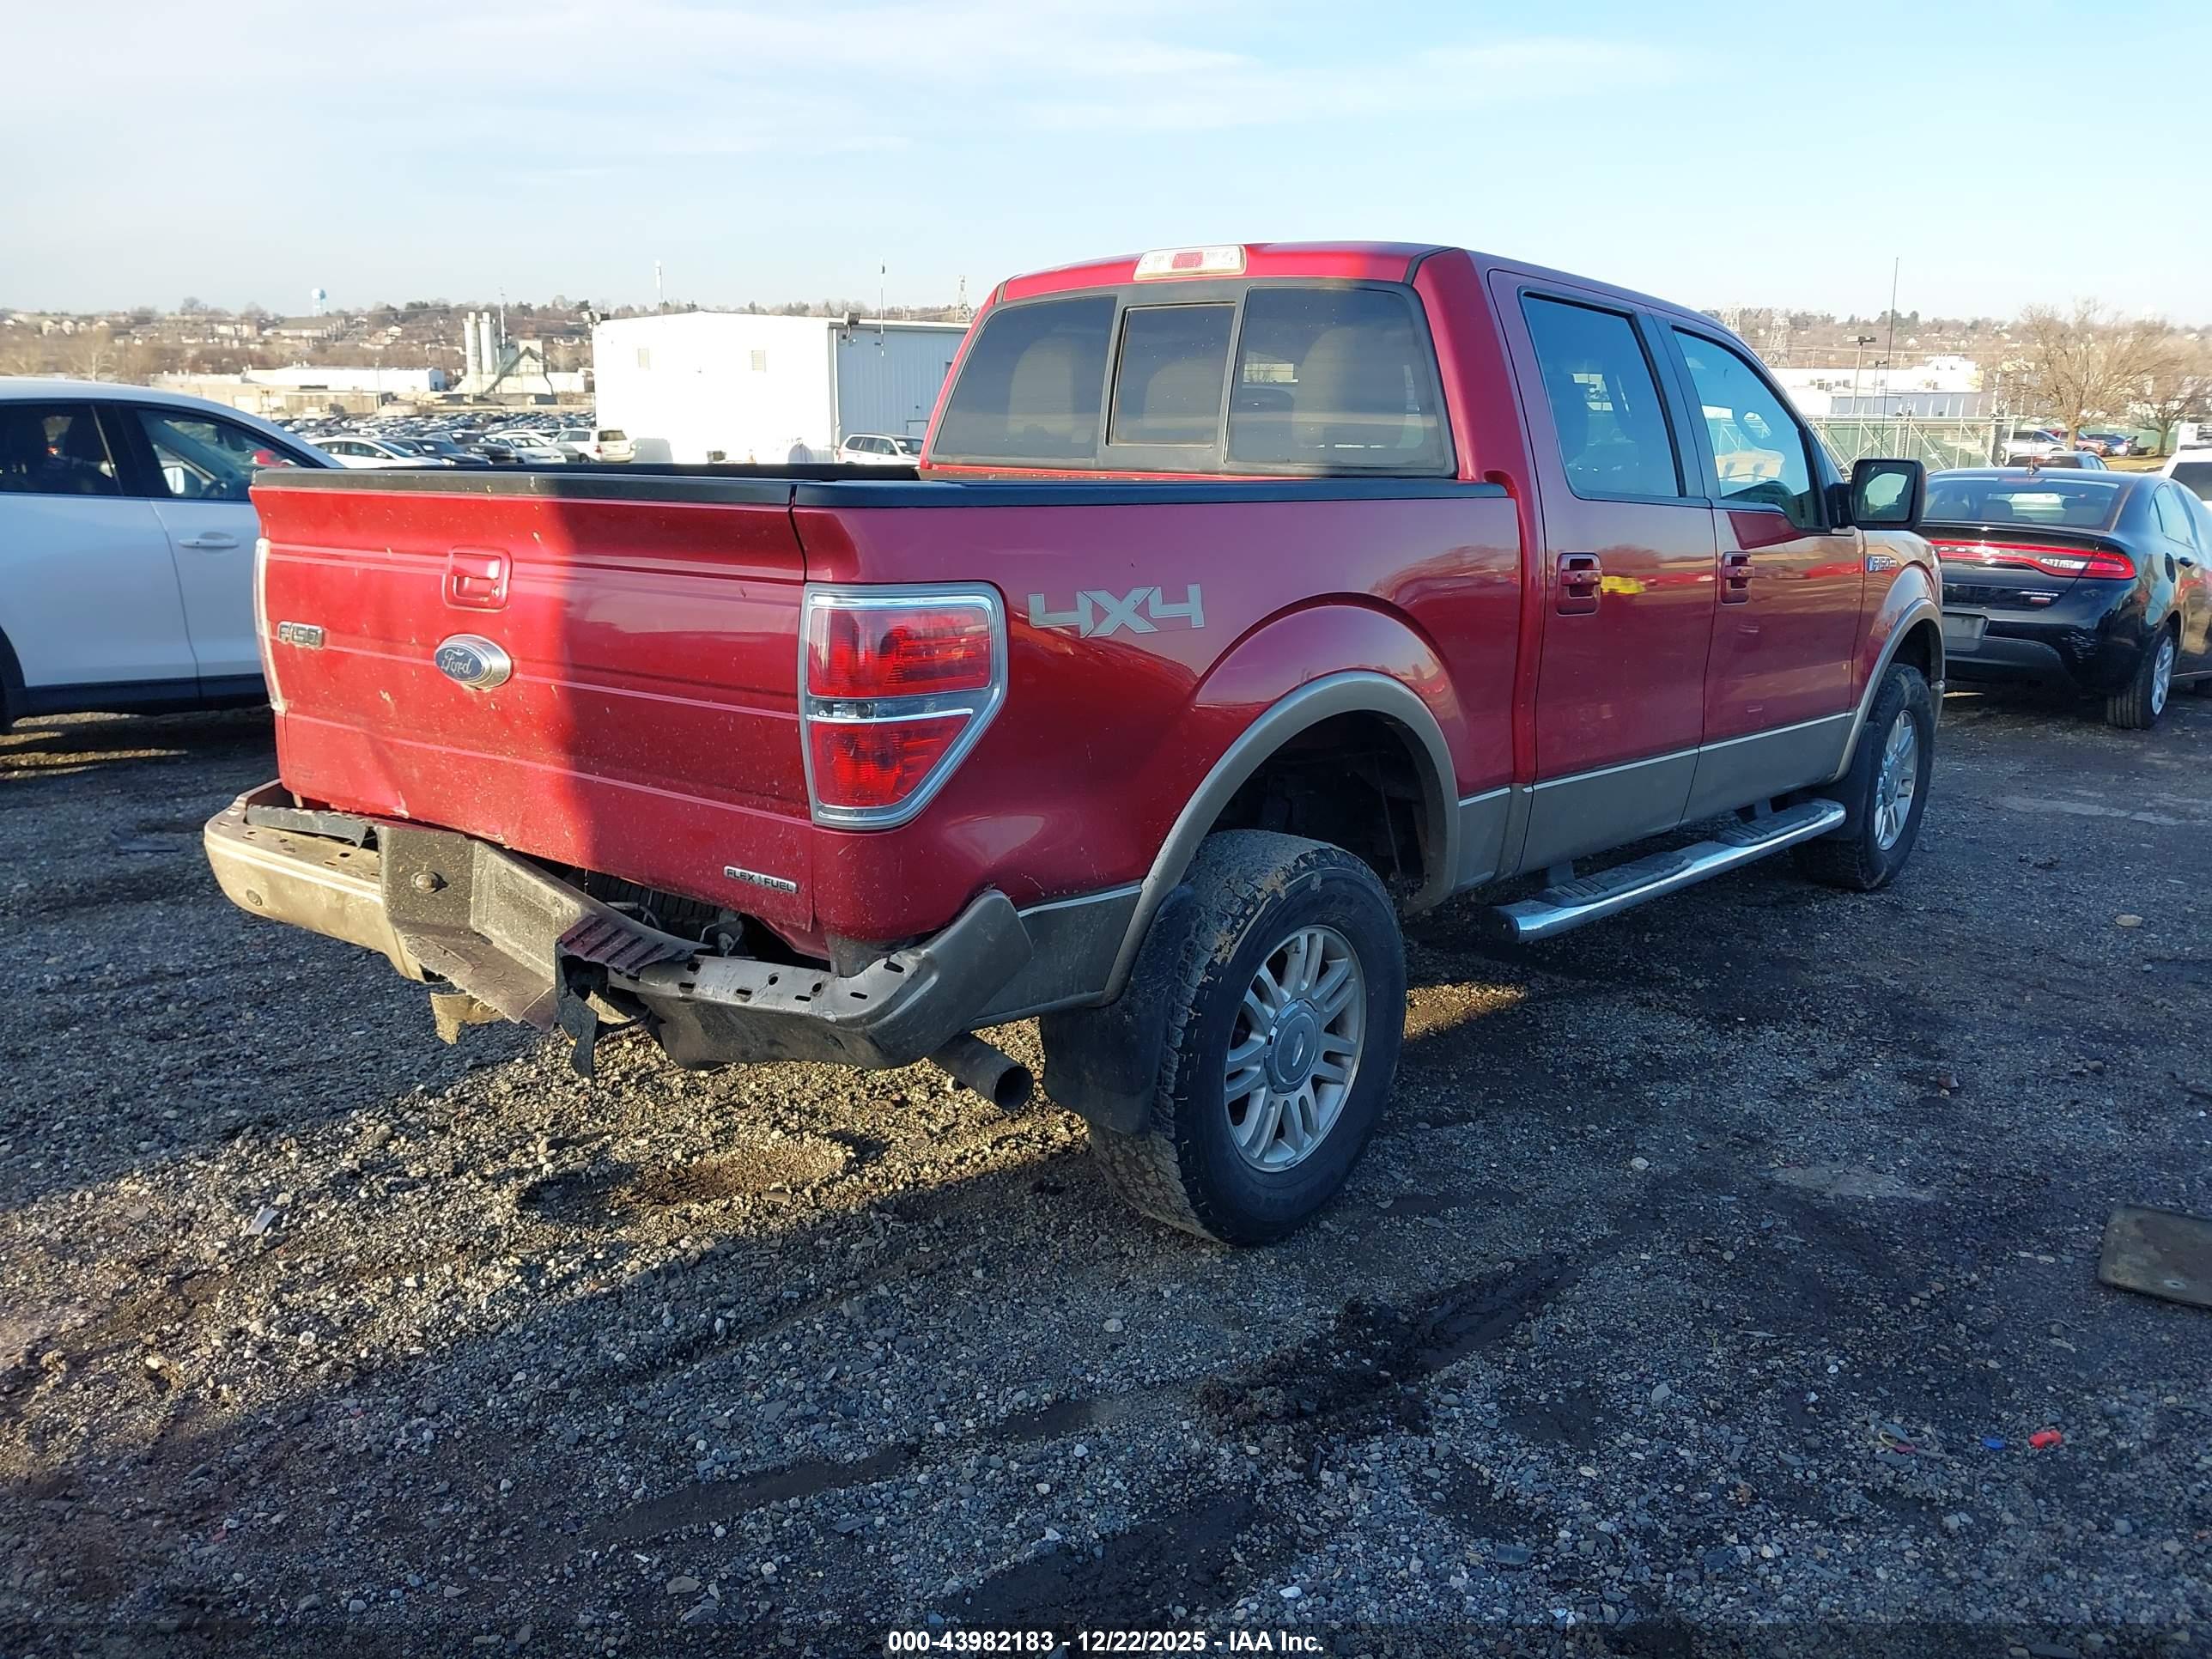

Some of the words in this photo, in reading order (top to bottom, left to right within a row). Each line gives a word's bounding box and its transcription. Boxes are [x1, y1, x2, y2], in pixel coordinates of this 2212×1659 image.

[441, 648, 472, 674] Ford
[726, 868, 756, 883] FLEX
[763, 878, 793, 892] FUEL
